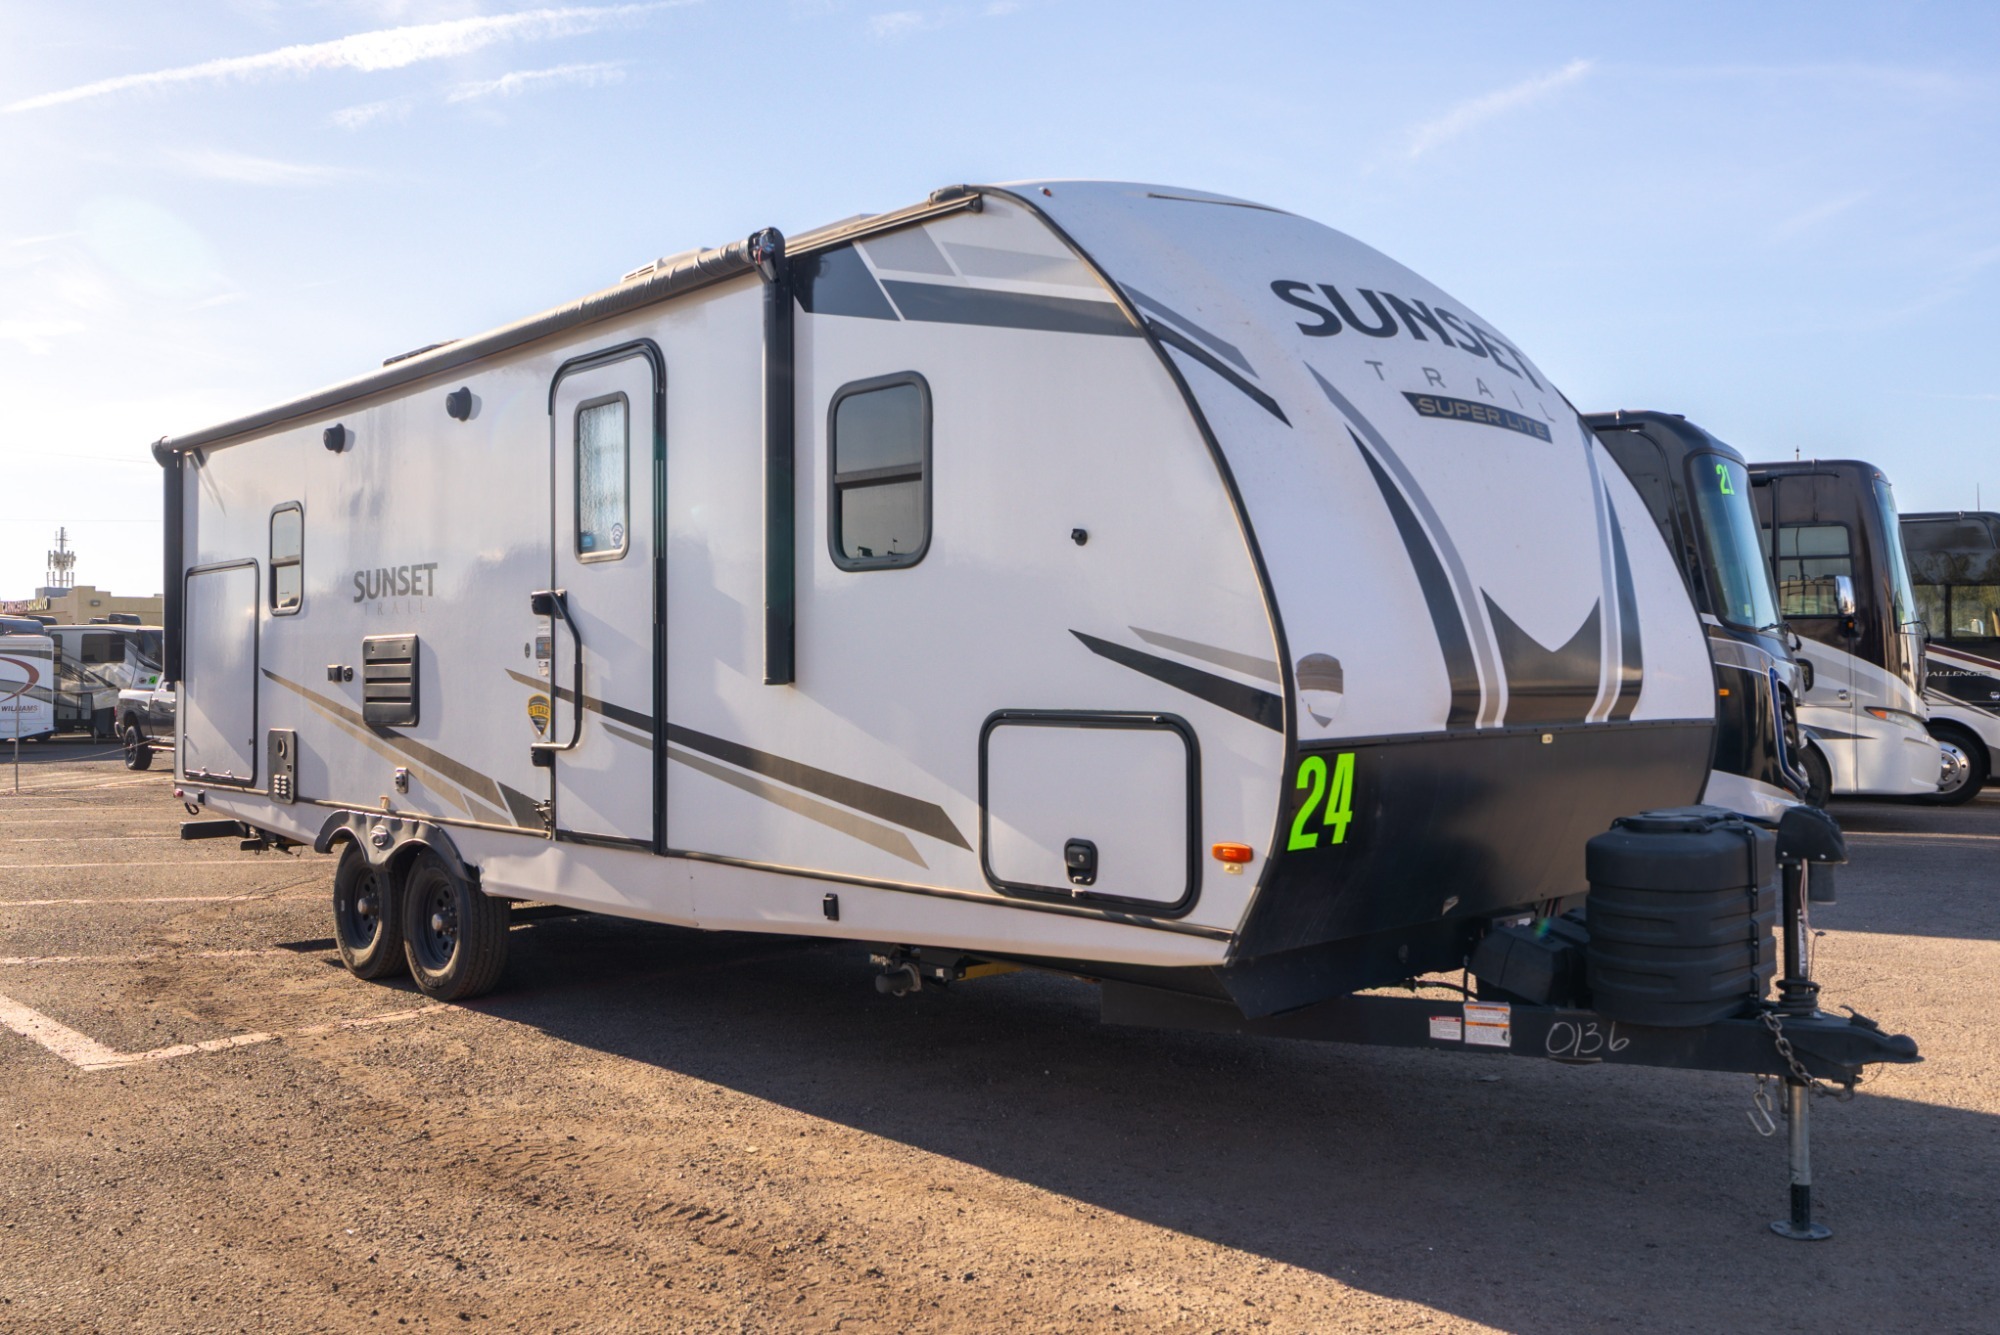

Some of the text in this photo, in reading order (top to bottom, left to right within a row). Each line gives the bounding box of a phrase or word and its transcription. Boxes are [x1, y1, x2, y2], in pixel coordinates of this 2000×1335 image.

[1270, 279, 1544, 393] SUNSET
[1364, 359, 1556, 423] TRAIL
[1418, 398, 1548, 439] SUPER LITE
[353, 562, 438, 604] SUNSET
[363, 599, 426, 616] TRAIL
[1287, 752, 1355, 851] 24
